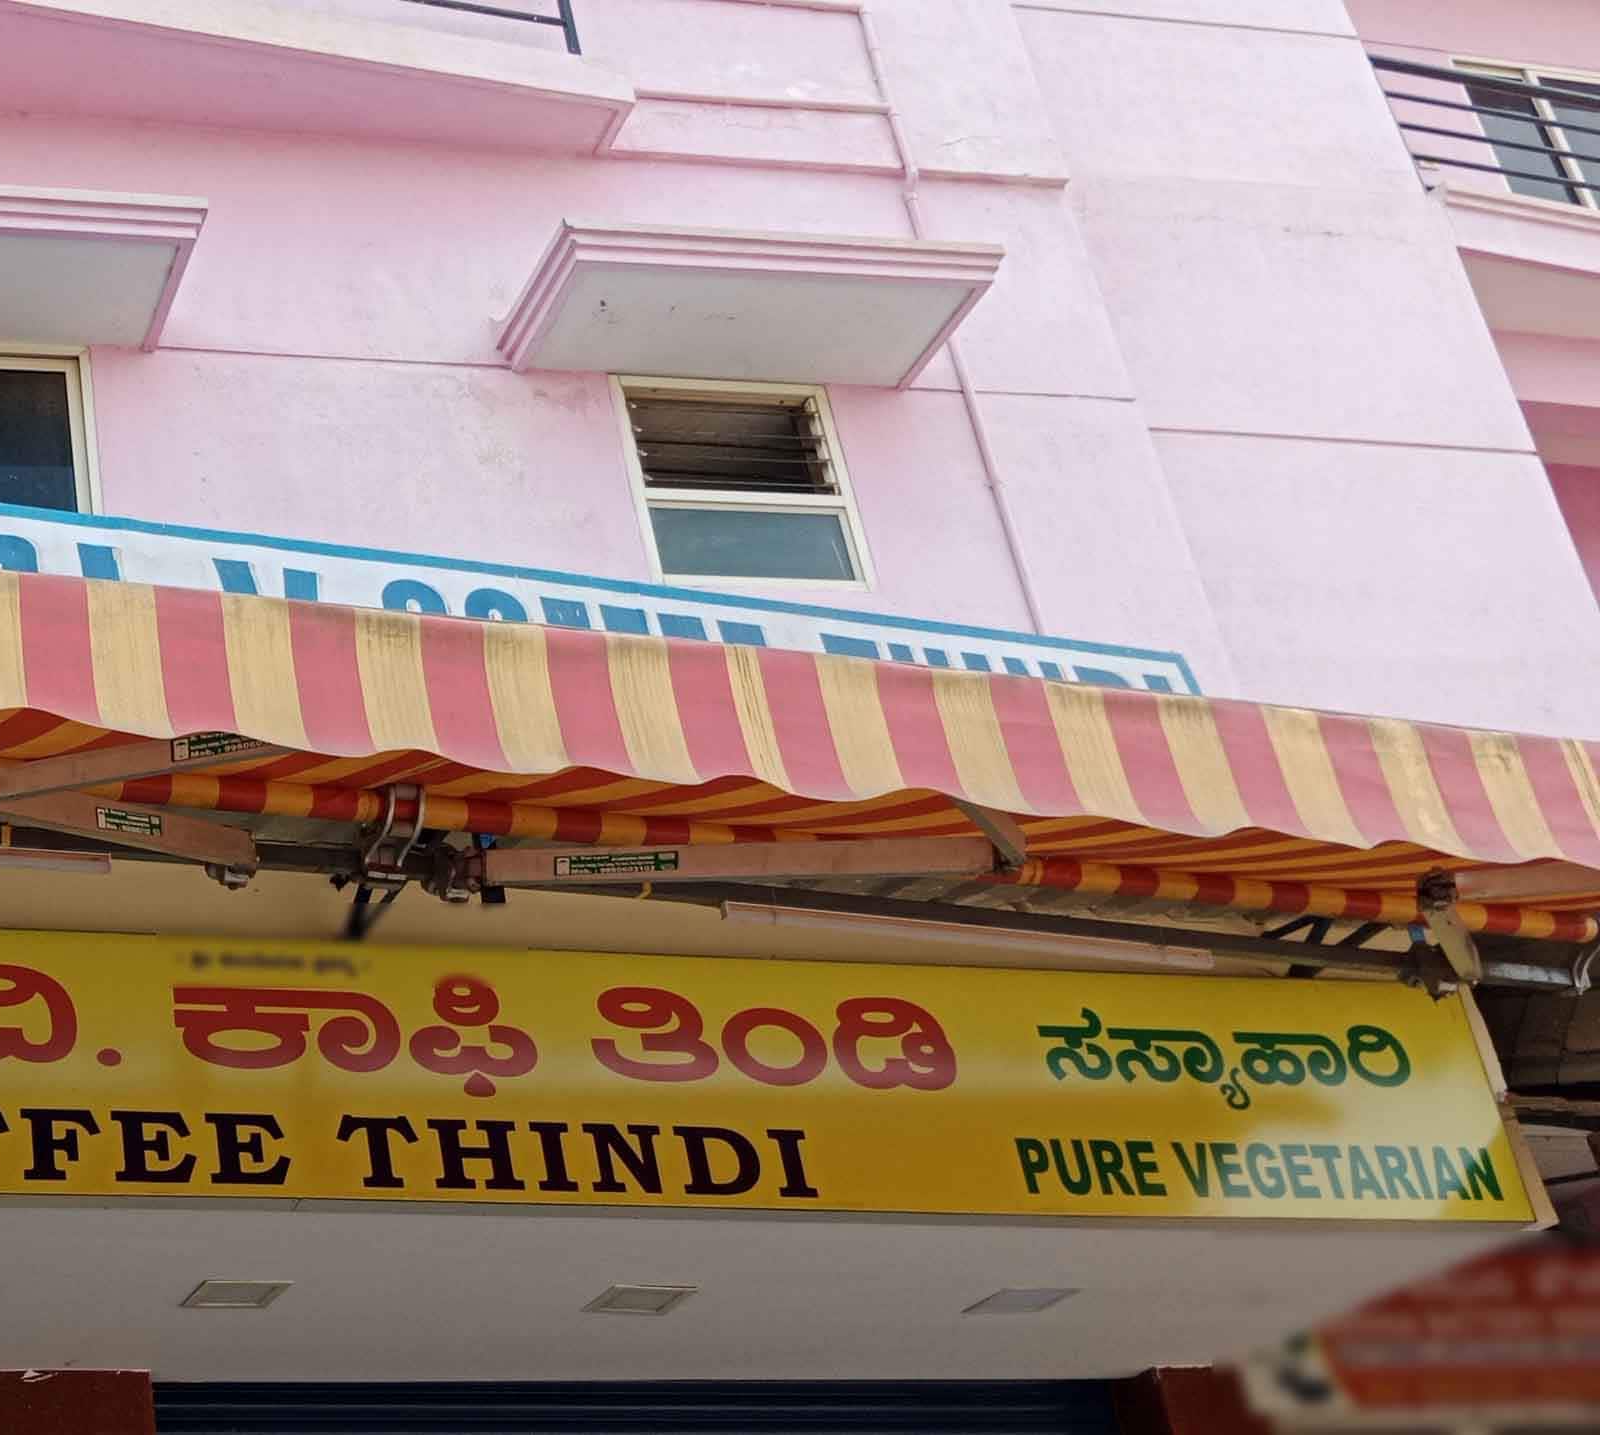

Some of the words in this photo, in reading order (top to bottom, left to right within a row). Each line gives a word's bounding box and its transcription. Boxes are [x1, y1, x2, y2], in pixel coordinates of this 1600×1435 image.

[172, 973, 539, 1098] ಕಾಫಿ
[591, 986, 958, 1091] ತಿಂಡಿ
[1037, 1007, 1413, 1110] ಸಸ್ಯಾಹಾರಿ
[334, 1115, 819, 1198] THINDI
[1015, 1137, 1168, 1197] PURE
[1172, 1141, 1505, 1201] VEGETARIAN
